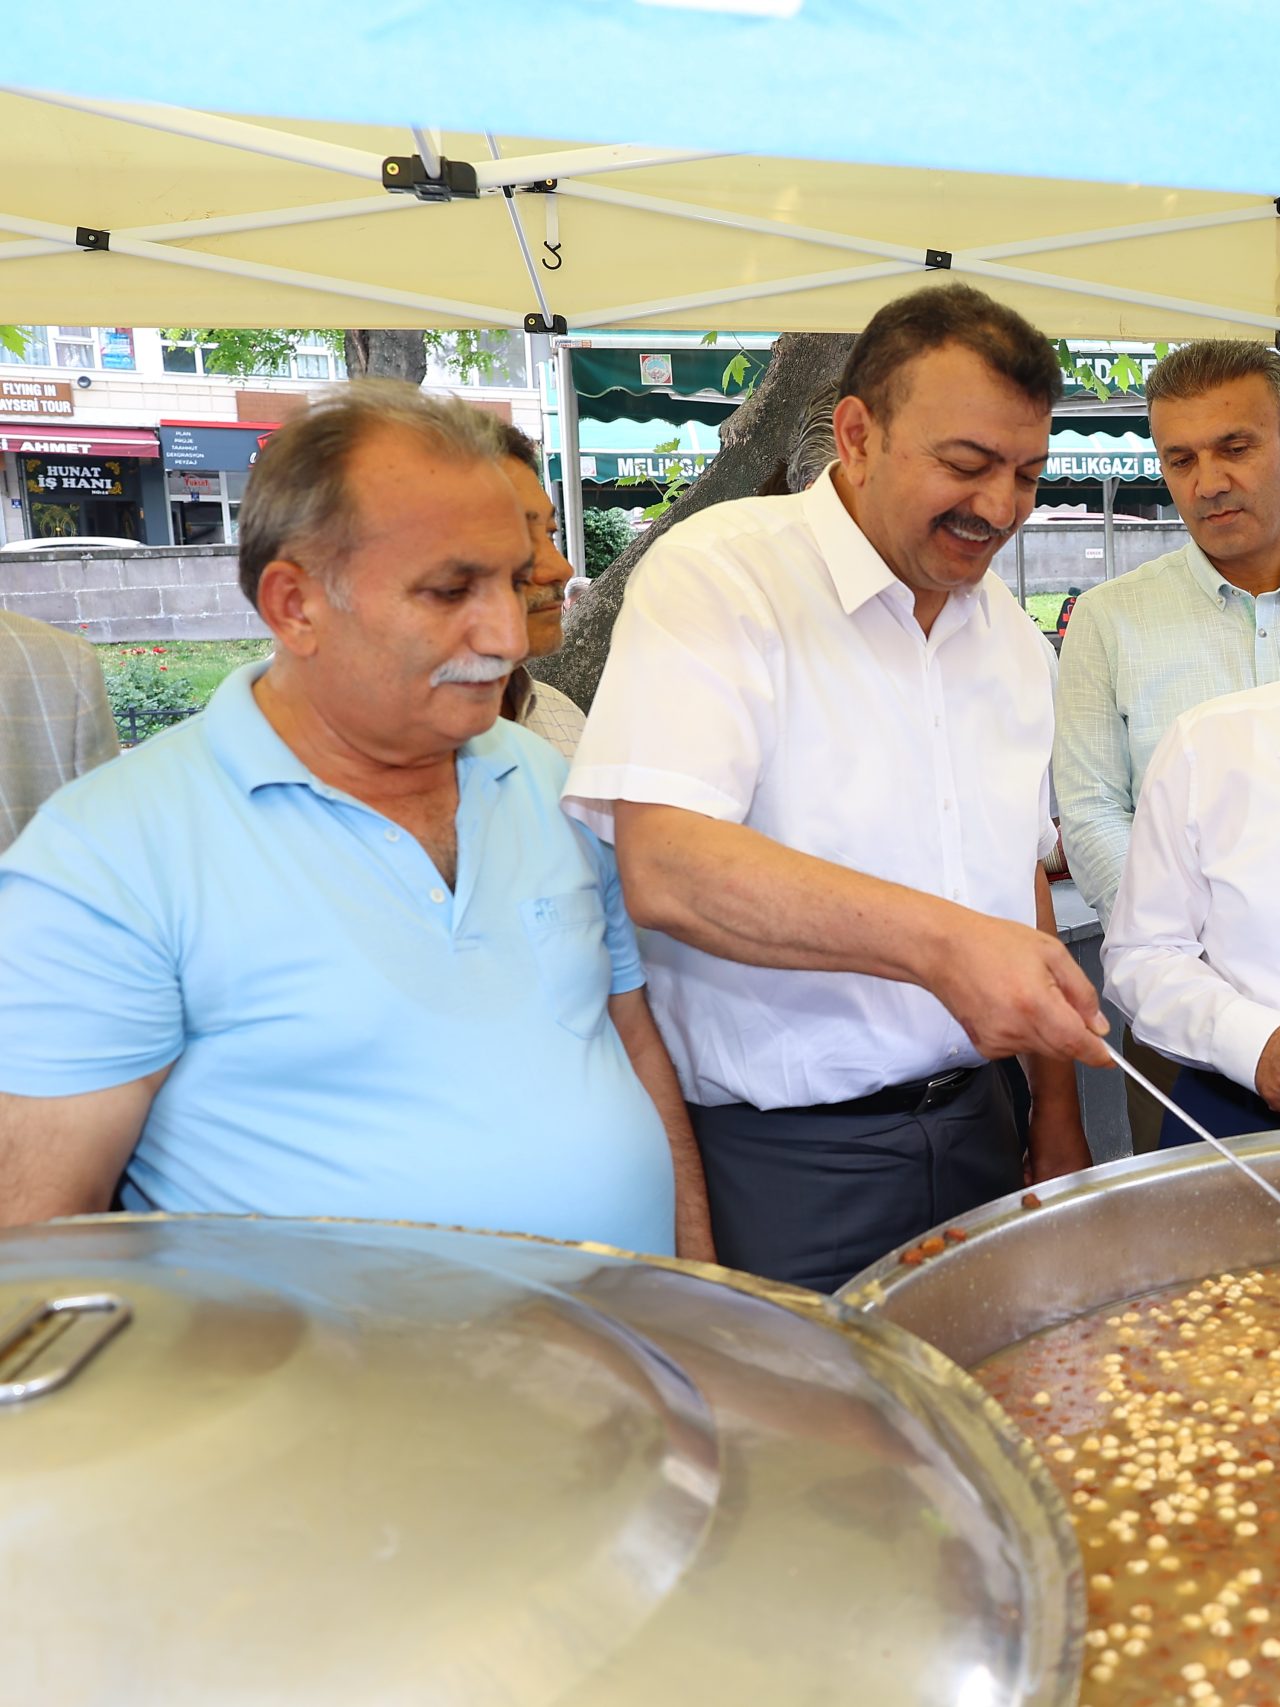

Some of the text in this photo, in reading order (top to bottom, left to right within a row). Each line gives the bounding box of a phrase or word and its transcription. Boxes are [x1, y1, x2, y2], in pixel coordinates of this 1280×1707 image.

[2, 382, 57, 397] FLYING IN
[40, 400, 72, 413] TOUR
[20, 441, 92, 454] AHMET
[46, 465, 102, 477] HUNAT
[37, 474, 113, 489] İŞ HANI
